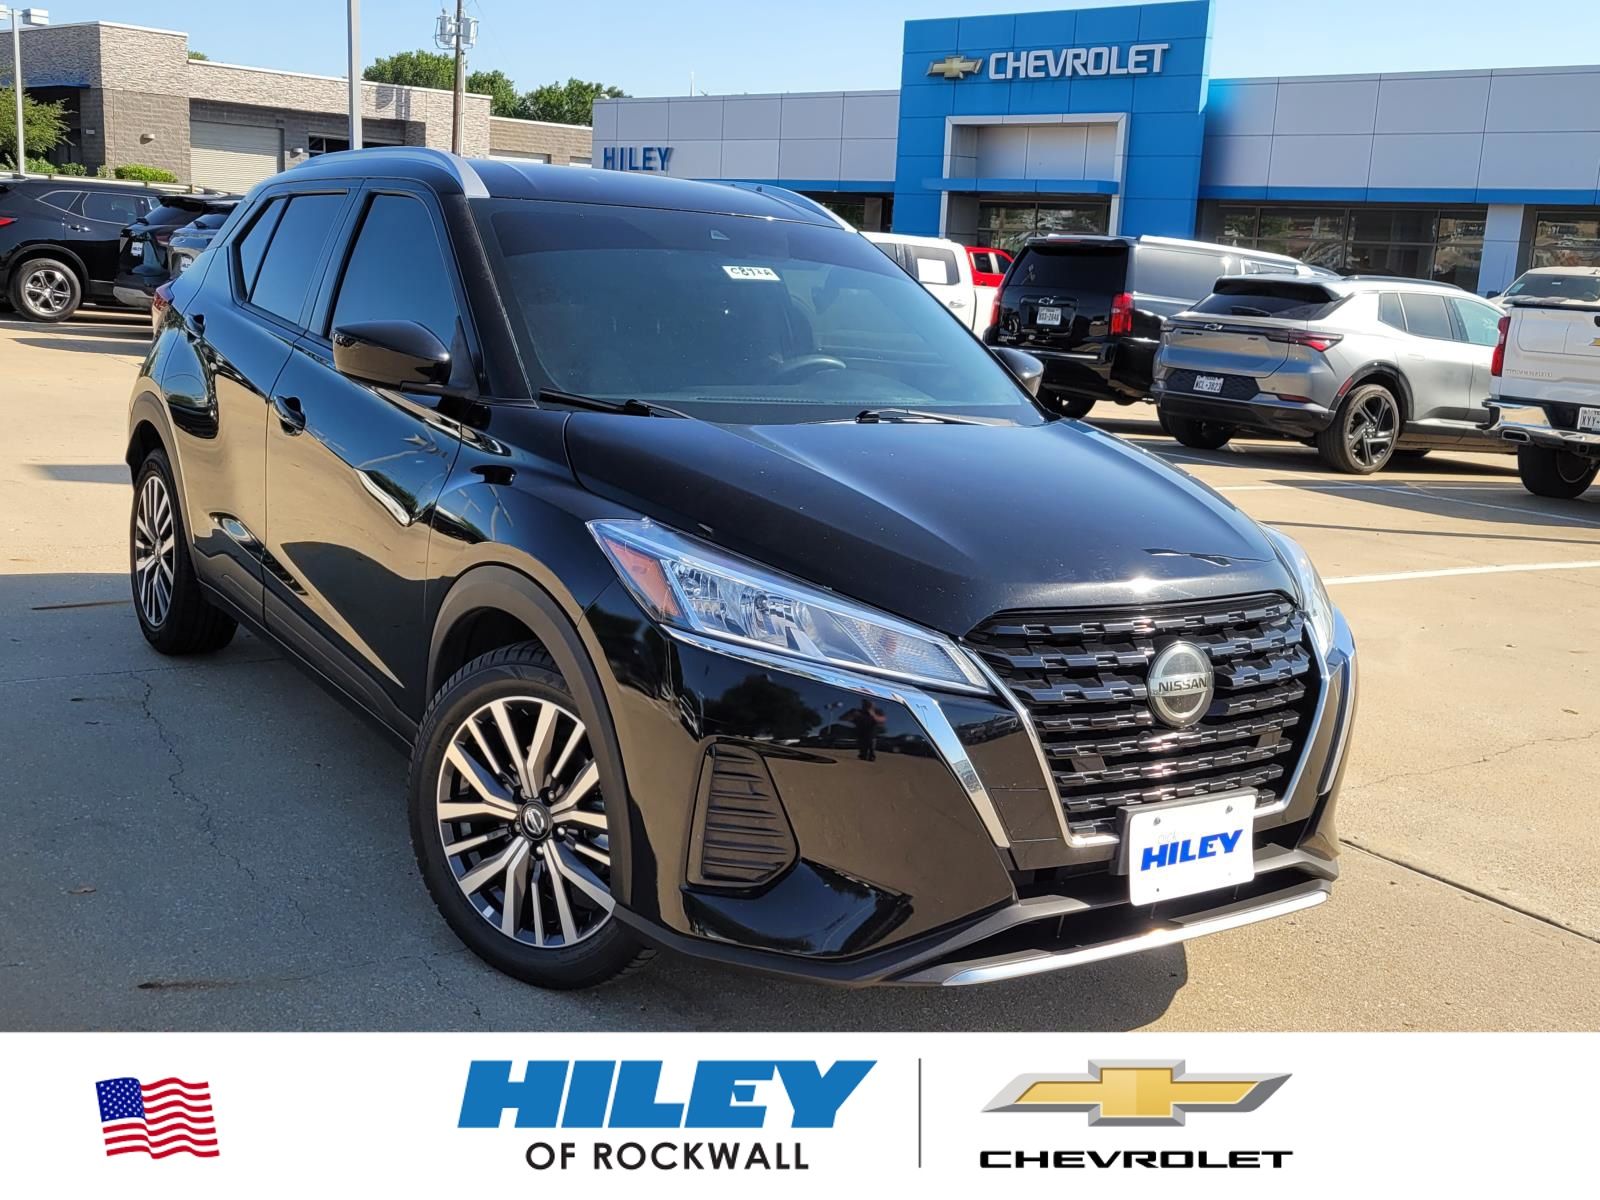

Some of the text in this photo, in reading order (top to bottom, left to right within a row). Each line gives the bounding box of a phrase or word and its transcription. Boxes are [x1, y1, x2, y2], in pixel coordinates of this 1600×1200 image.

[988, 43, 1169, 80] CHEVROLET
[603, 147, 673, 171] HILEY
[1158, 677, 1207, 692] NISSAN
[1140, 829, 1244, 871] HILEY
